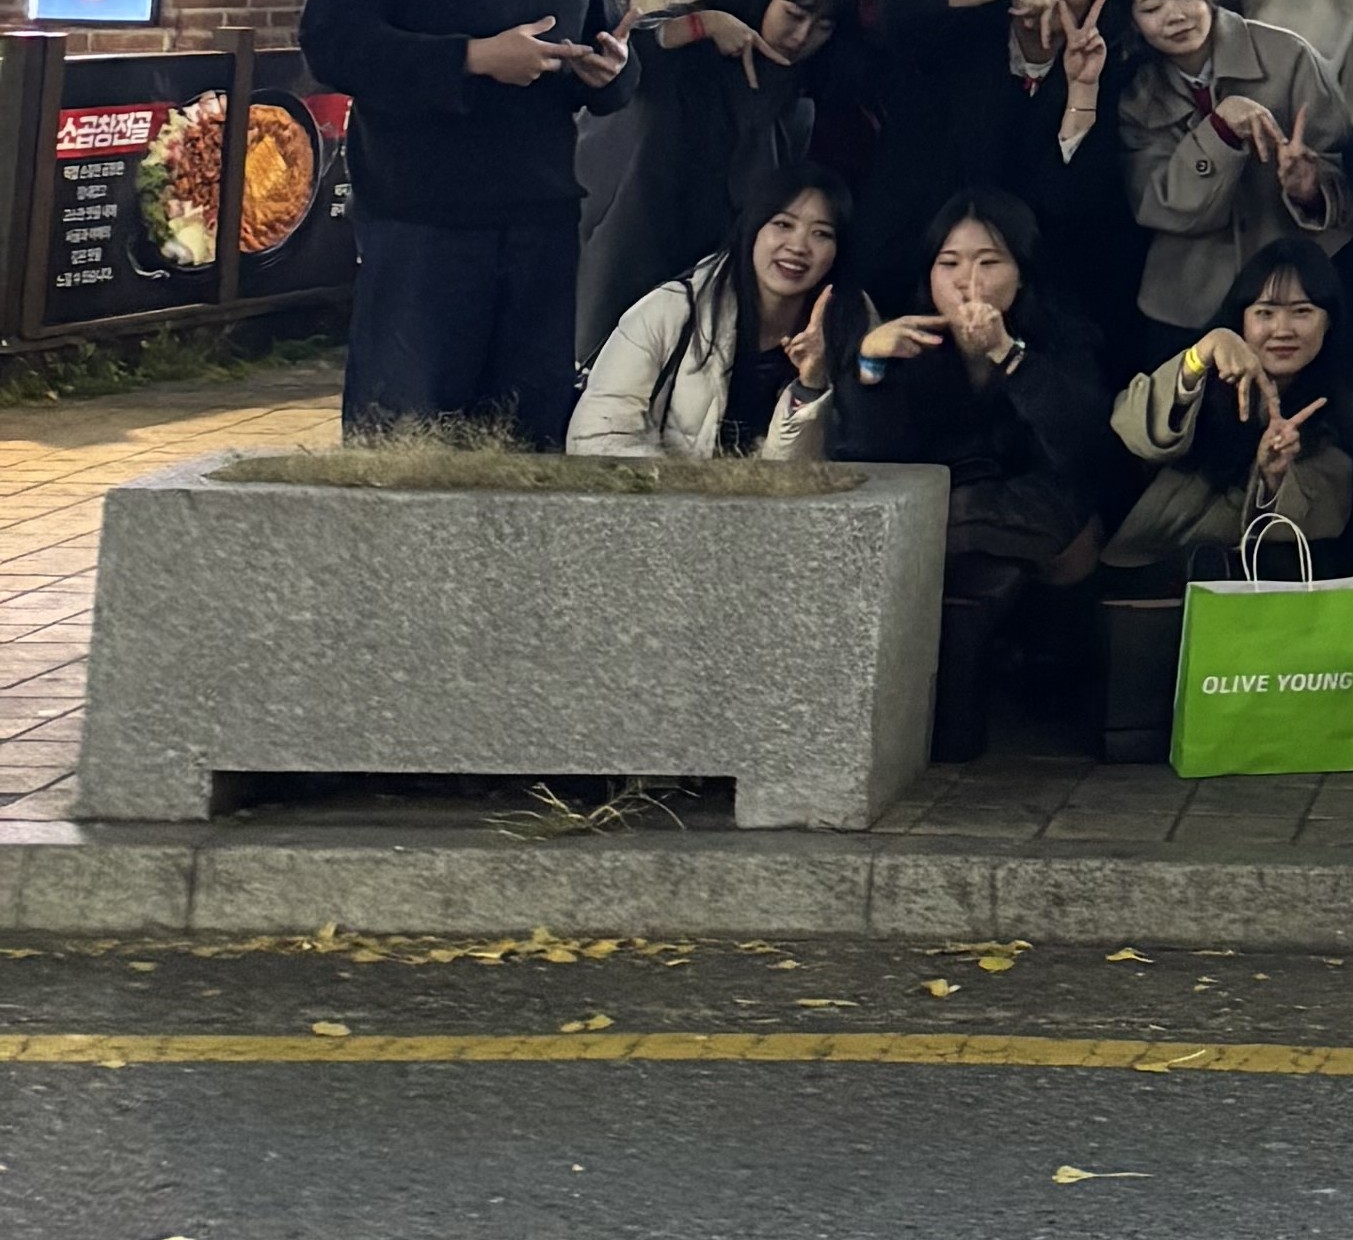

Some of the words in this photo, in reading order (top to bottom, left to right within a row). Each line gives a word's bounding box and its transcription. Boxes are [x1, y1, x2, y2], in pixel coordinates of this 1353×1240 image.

[56, 111, 152, 150] 소곱창전골
[1202, 675, 1270, 694] OLIVE
[1277, 672, 1353, 692] YOUNG
